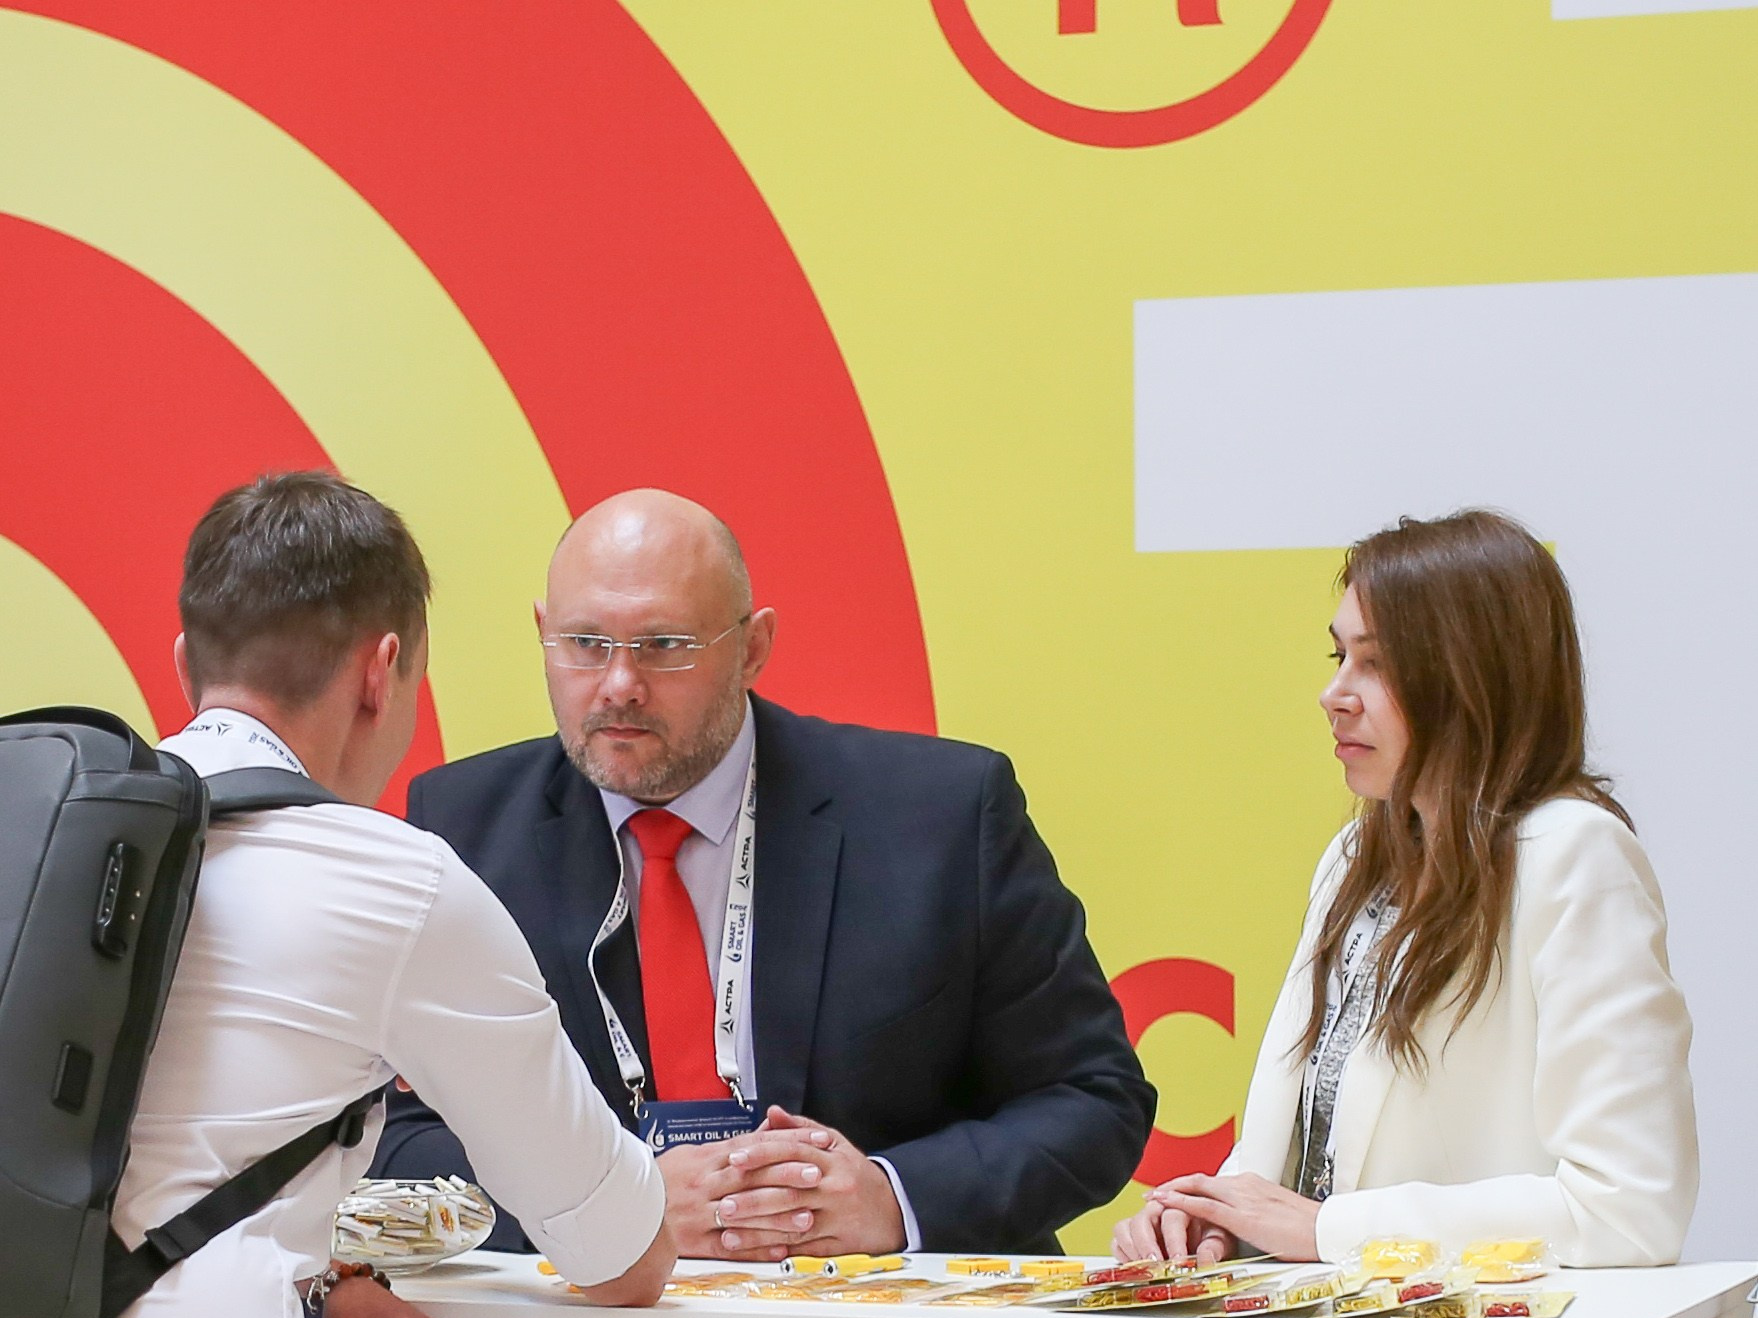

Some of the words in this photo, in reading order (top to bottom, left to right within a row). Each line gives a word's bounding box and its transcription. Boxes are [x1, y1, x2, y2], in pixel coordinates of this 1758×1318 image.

[738, 912, 747, 928] GAS
[728, 920, 736, 949] SMART
[736, 937, 744, 950] OIL
[667, 1131, 703, 1143] SMART
[704, 1131, 722, 1140] OIL
[723, 1130, 731, 1139] &
